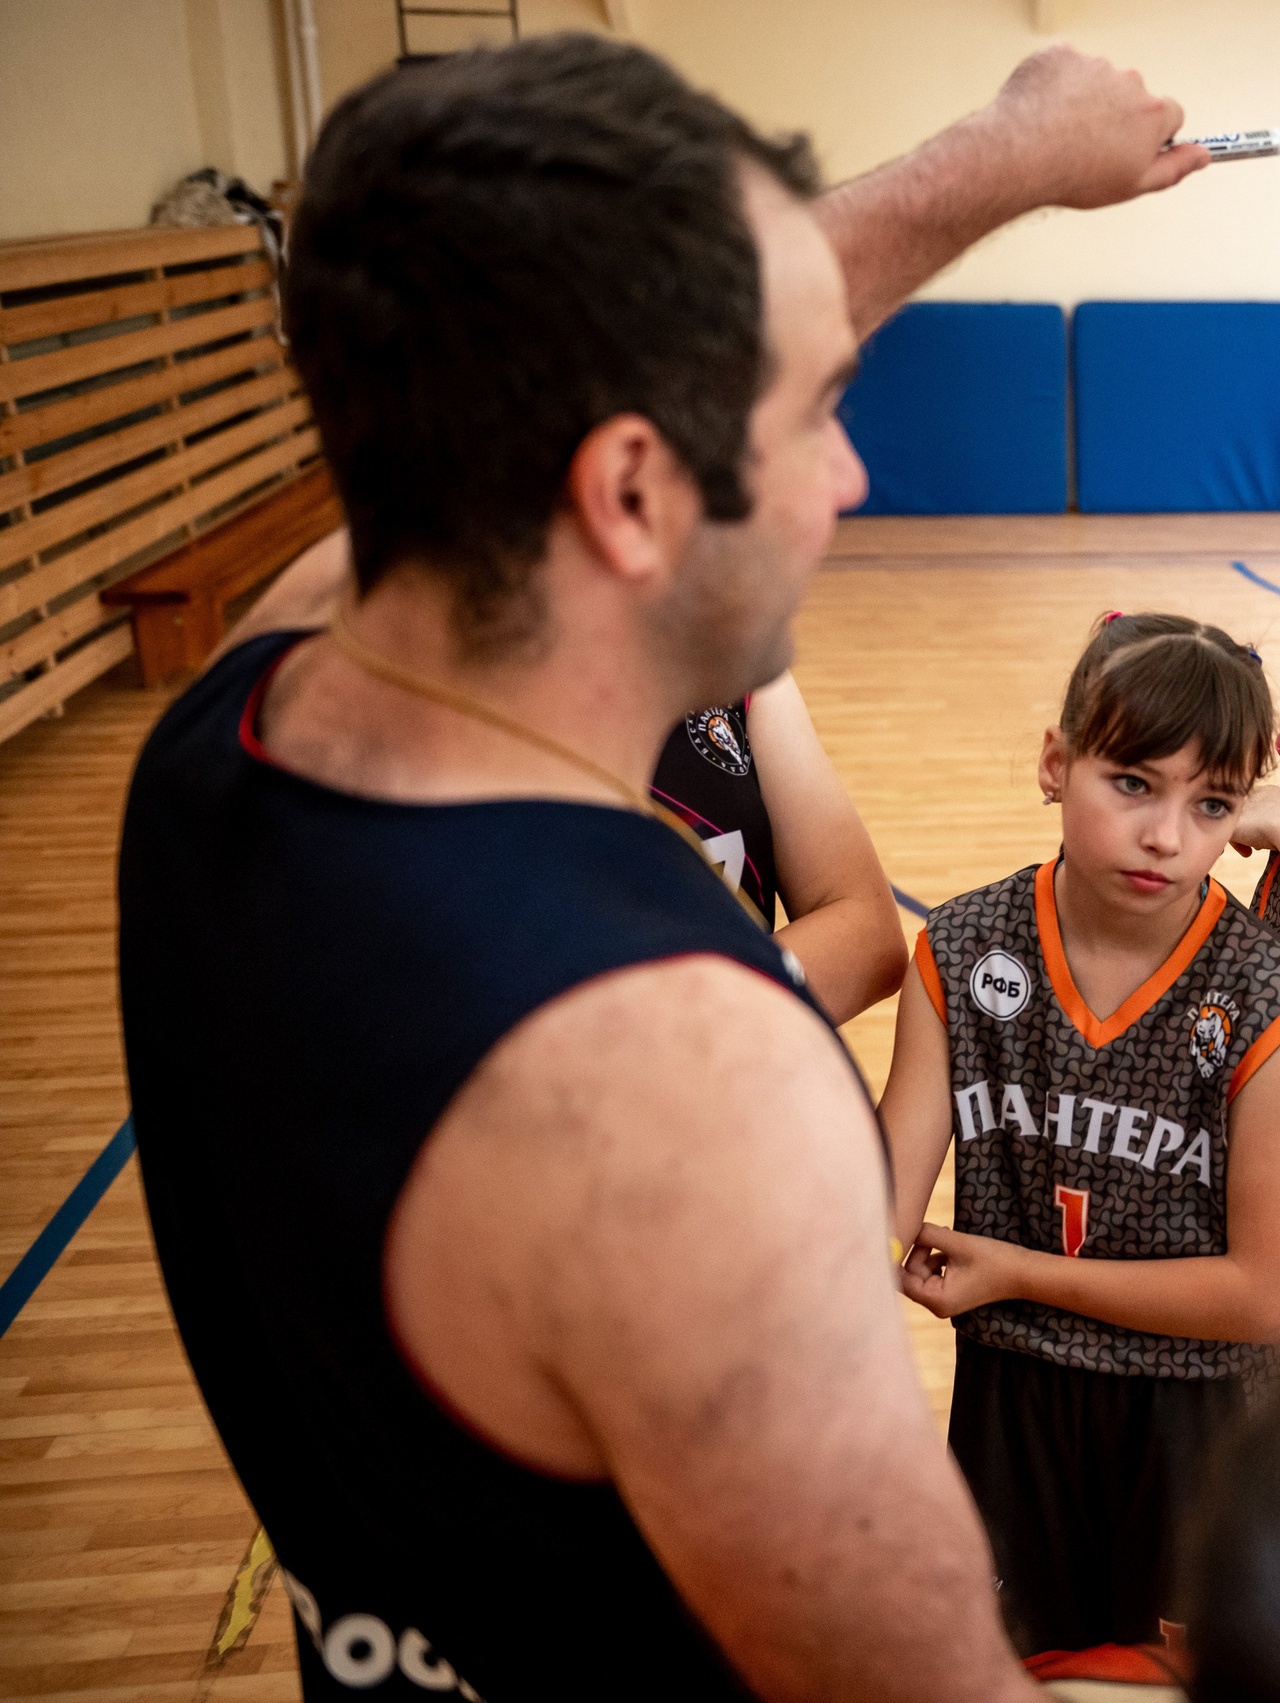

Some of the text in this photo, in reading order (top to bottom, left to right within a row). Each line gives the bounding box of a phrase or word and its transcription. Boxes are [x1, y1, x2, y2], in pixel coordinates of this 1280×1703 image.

[982, 973, 1021, 999] РФБ
[954, 1080, 1212, 1189] ПАНТЕРА
[1054, 1183, 1090, 1257] 1
